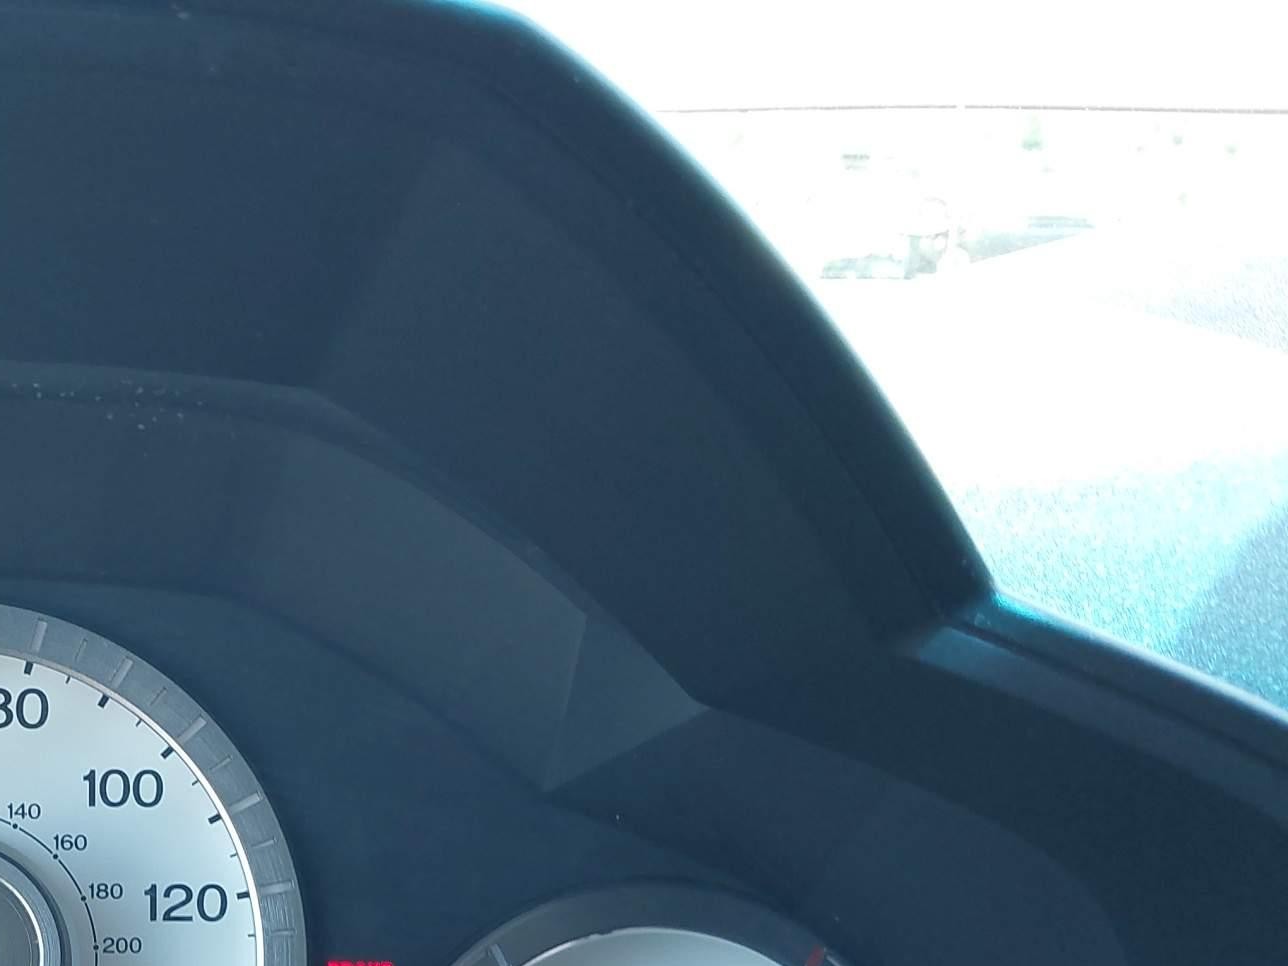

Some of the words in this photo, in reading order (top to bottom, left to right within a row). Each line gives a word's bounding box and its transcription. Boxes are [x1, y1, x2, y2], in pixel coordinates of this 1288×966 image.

[82, 768, 164, 808] 100
[7, 803, 42, 820] 140
[53, 833, 88, 851] 160
[88, 883, 124, 900] 180
[143, 883, 228, 923] 120
[102, 937, 142, 955] 200
